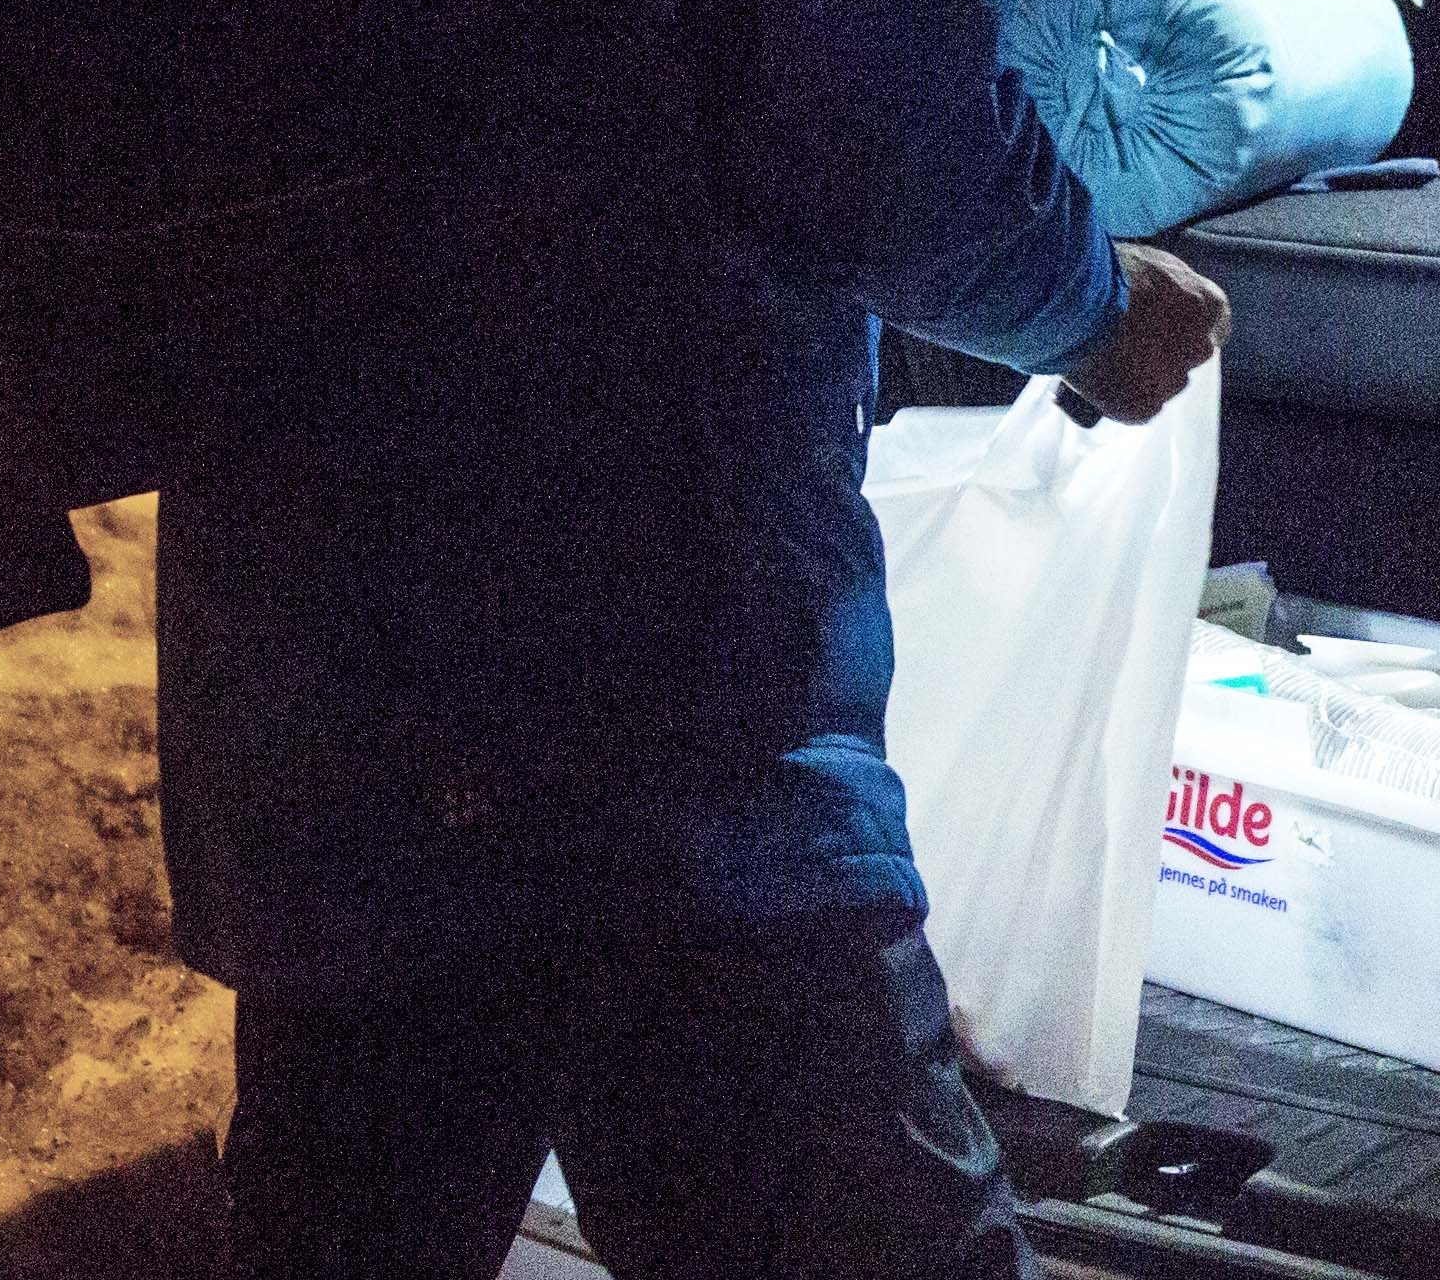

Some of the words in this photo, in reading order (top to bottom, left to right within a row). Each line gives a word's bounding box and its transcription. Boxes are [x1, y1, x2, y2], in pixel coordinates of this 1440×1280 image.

[1159, 861, 1206, 891] jennes
[1208, 877, 1227, 897] på
[1230, 884, 1288, 913] smaken
